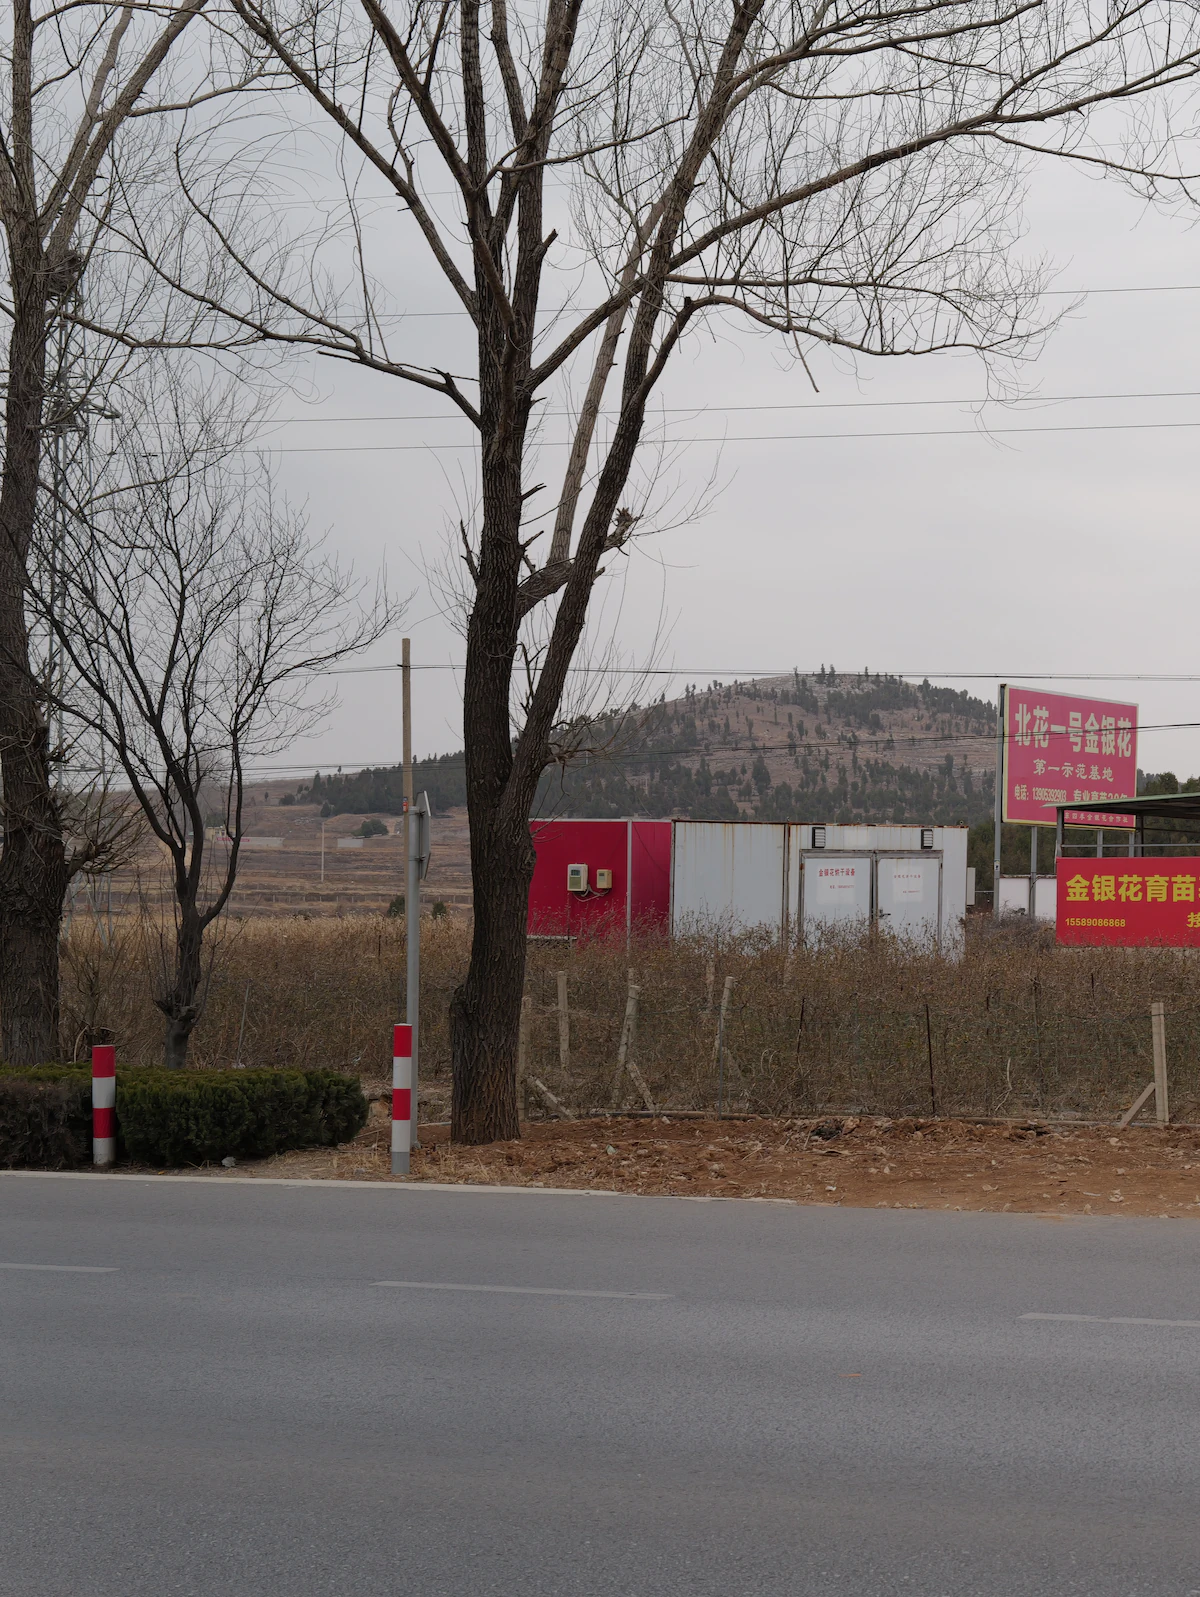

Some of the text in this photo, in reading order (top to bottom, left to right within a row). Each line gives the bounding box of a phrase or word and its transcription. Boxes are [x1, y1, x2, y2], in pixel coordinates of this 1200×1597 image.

[1015, 703, 1132, 758] 北花一号金银花
[1033, 758, 1114, 782] 第一示范基地
[1065, 917, 1126, 928] 15589086868
